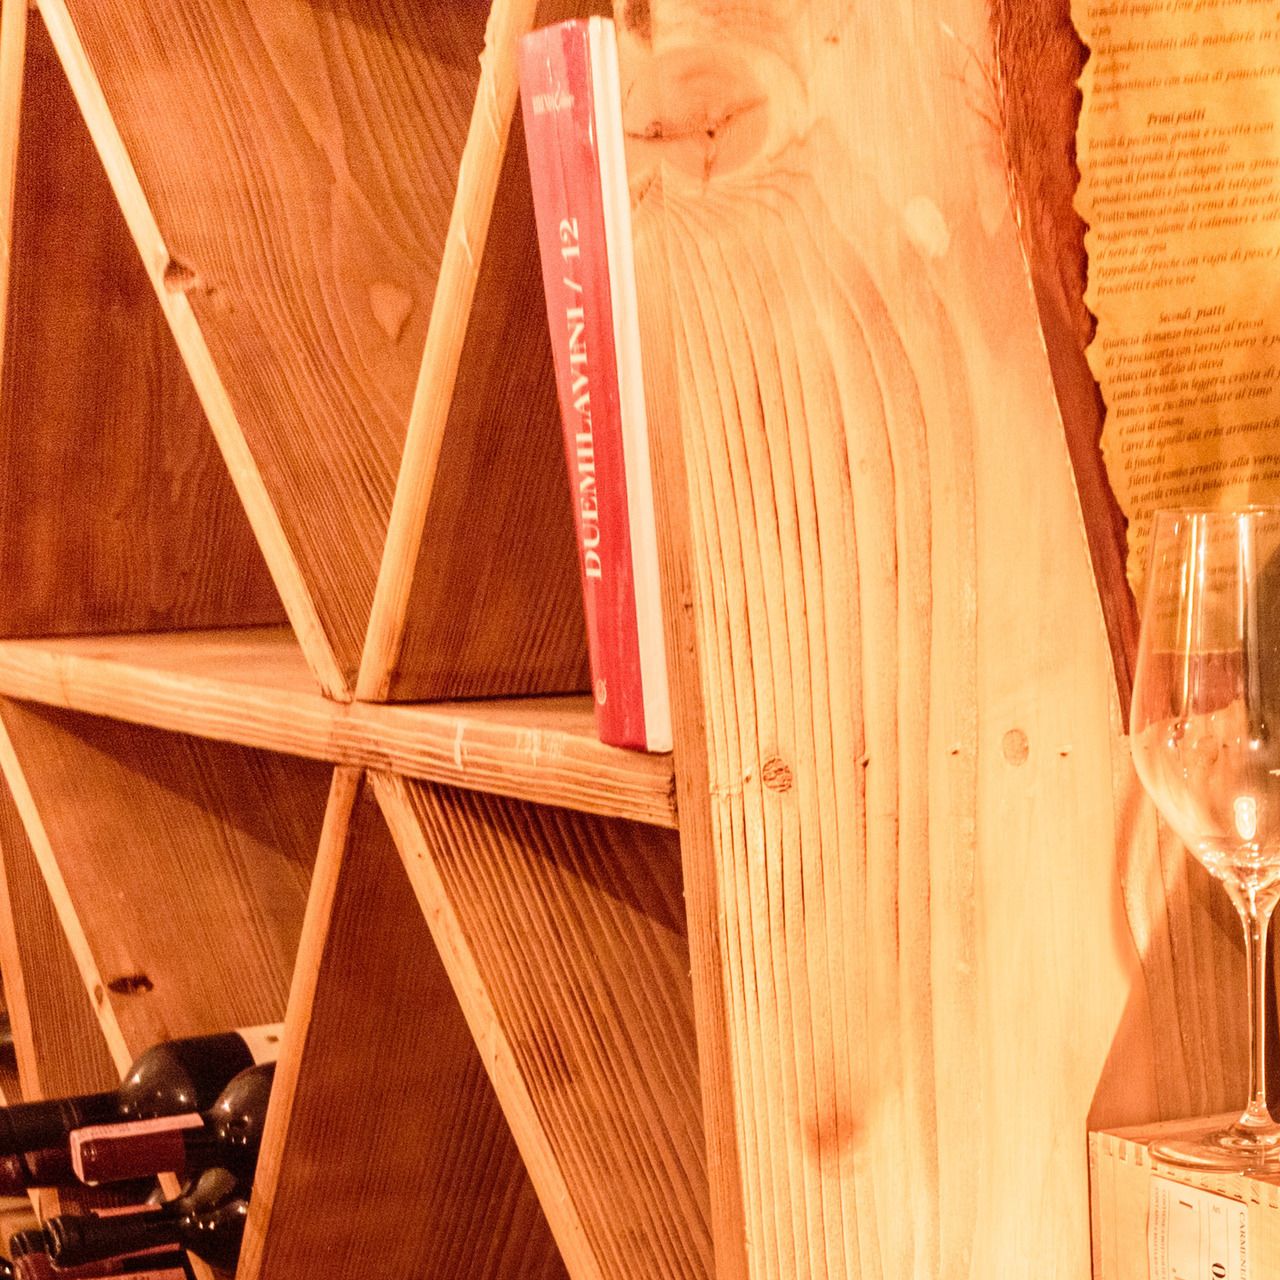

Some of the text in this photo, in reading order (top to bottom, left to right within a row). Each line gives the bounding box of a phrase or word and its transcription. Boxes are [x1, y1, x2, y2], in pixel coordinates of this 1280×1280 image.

[1147, 107, 1205, 127] Primi piatti
[559, 217, 579, 259] 12
[1159, 304, 1225, 323] Secondi piatti
[565, 304, 603, 580] DUEMILAVINI
